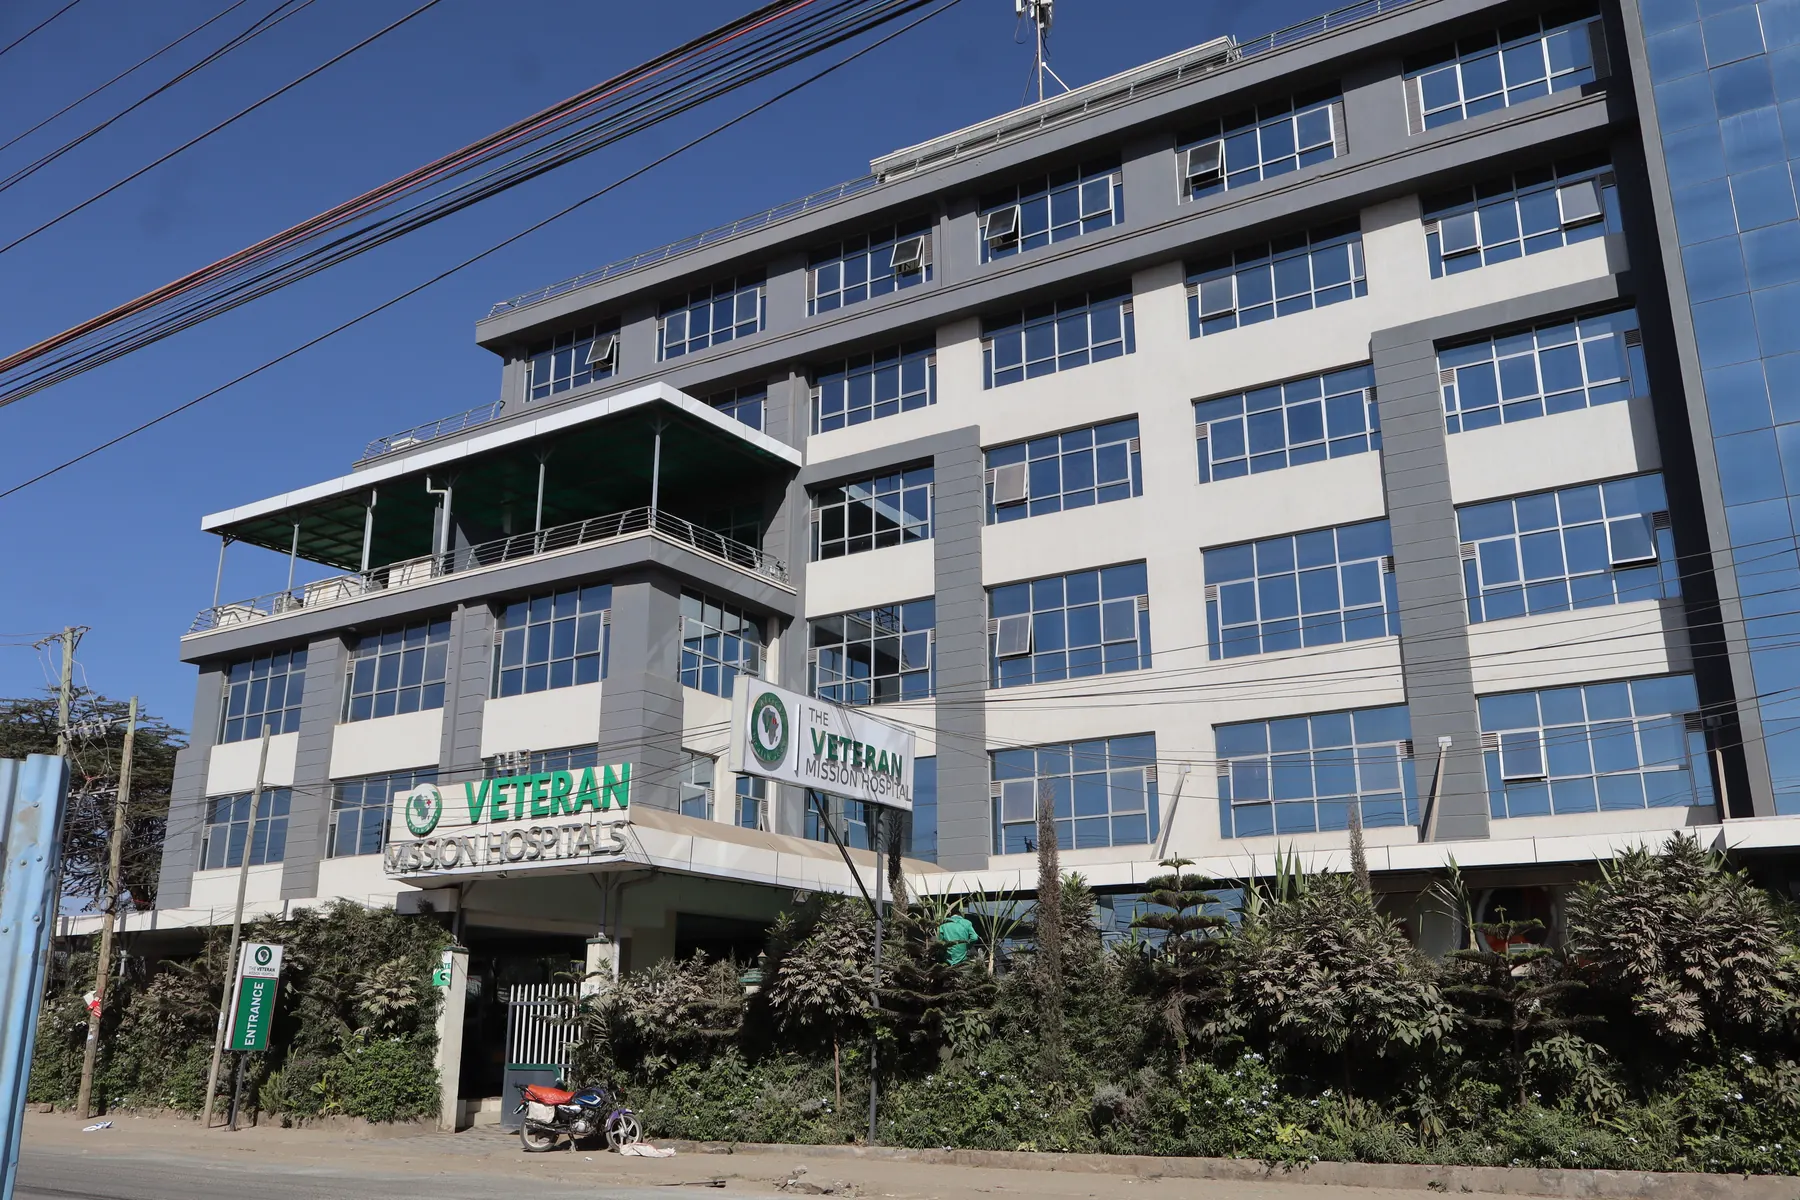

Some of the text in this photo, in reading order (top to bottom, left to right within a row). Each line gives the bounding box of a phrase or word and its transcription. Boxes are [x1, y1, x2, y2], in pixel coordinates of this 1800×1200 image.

[808, 706, 829, 727] THE
[805, 757, 912, 802] MISSION HOSPITAL
[810, 727, 903, 782] VETERAN
[465, 762, 632, 824] VETERAN
[383, 820, 628, 873] MISSION HOSPITALS
[244, 982, 265, 1046] ENTRANCE
